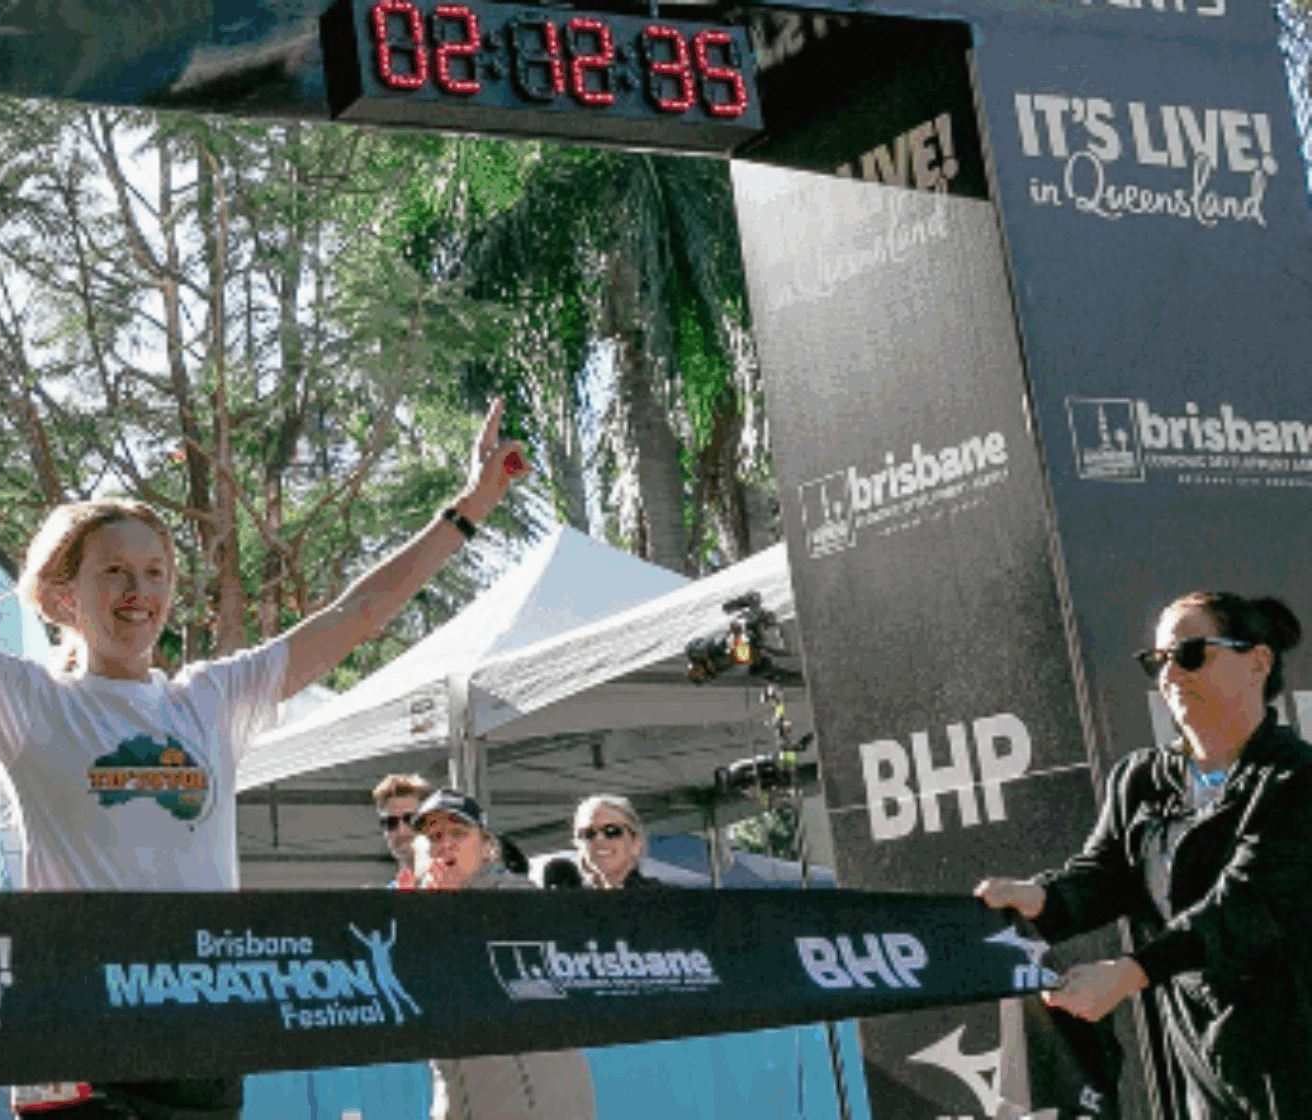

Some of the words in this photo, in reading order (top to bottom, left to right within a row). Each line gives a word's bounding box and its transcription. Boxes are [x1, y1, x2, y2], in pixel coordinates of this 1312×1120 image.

[836, 112, 960, 193] IVE!
[1014, 93, 1122, 163] IT'S
[1128, 101, 1279, 176] LIVE!
[1029, 177, 1063, 207] in
[1064, 150, 1268, 228] Queensland
[848, 431, 1009, 511] brisbane
[859, 712, 1033, 842] BHP
[196, 929, 314, 958] Brisbane
[546, 940, 713, 978] brisbane
[794, 933, 929, 989] BHP
[104, 960, 377, 1006] MARATHON
[280, 1000, 386, 1030] Festival
